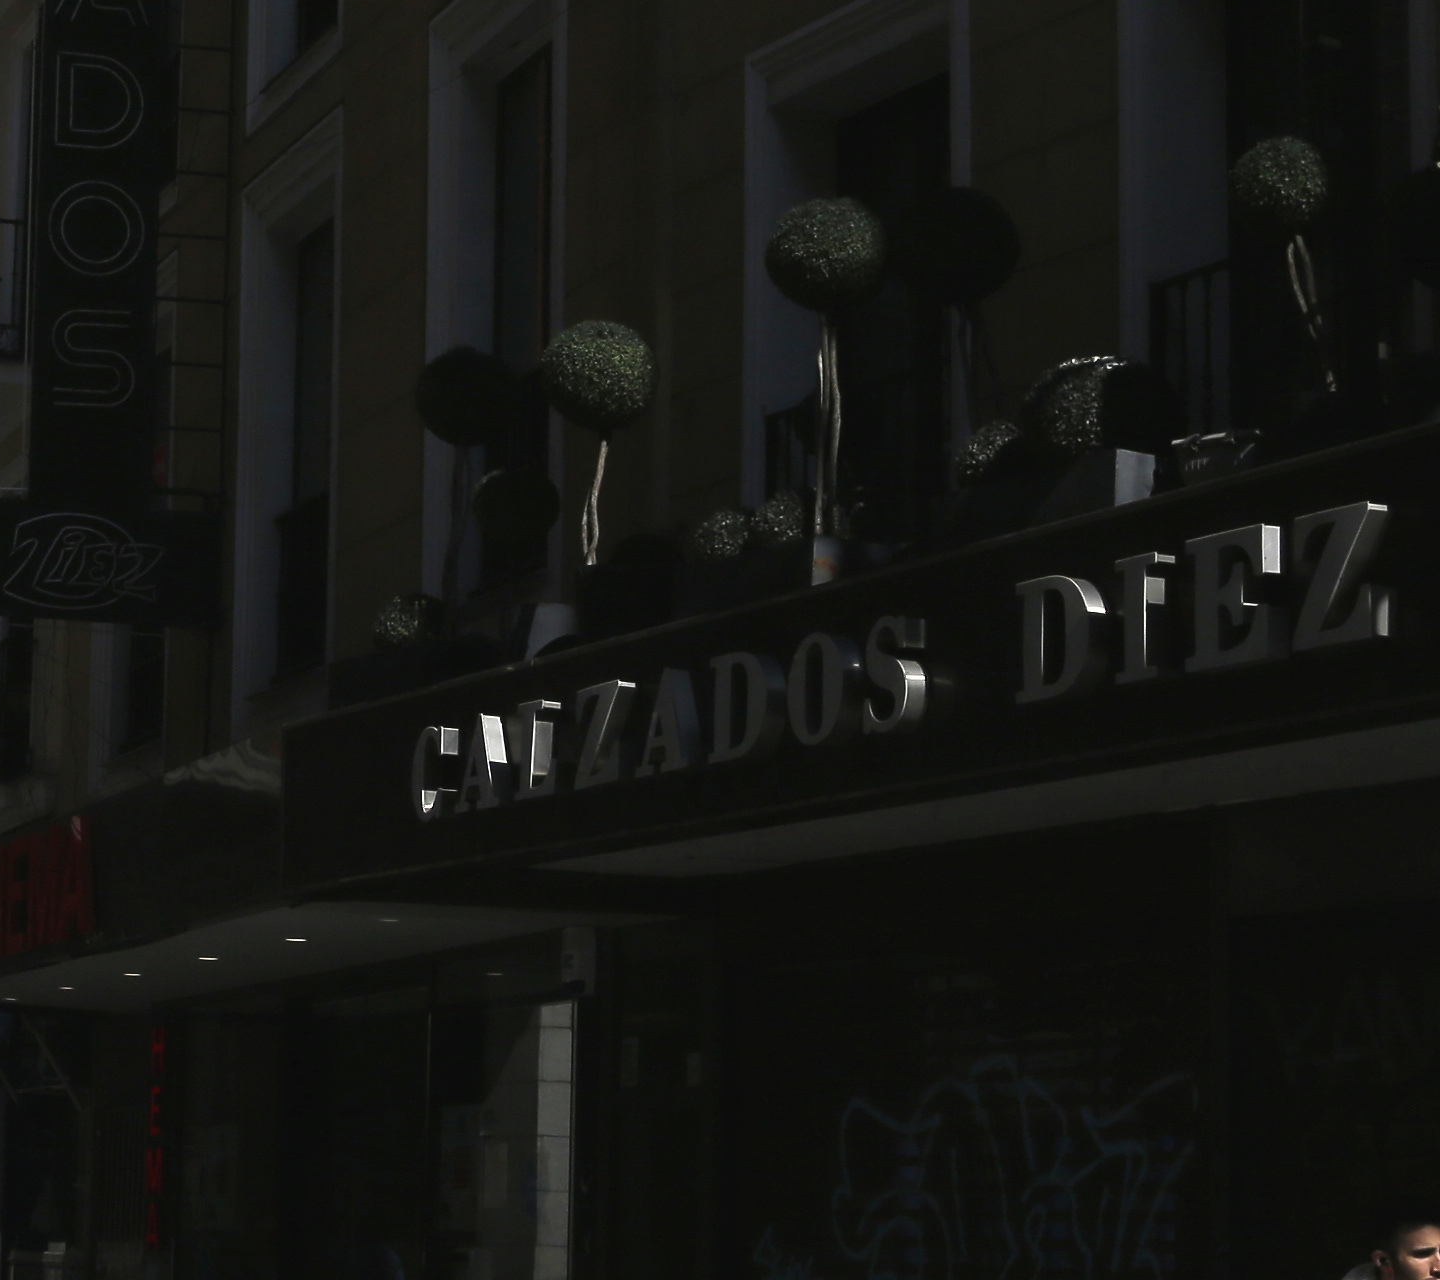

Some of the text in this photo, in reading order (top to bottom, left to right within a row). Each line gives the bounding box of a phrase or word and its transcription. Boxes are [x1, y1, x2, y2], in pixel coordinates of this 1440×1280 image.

[412, 501, 1390, 822] CALZADOS DIEZ
[146, 1025, 167, 1249] HEMA
